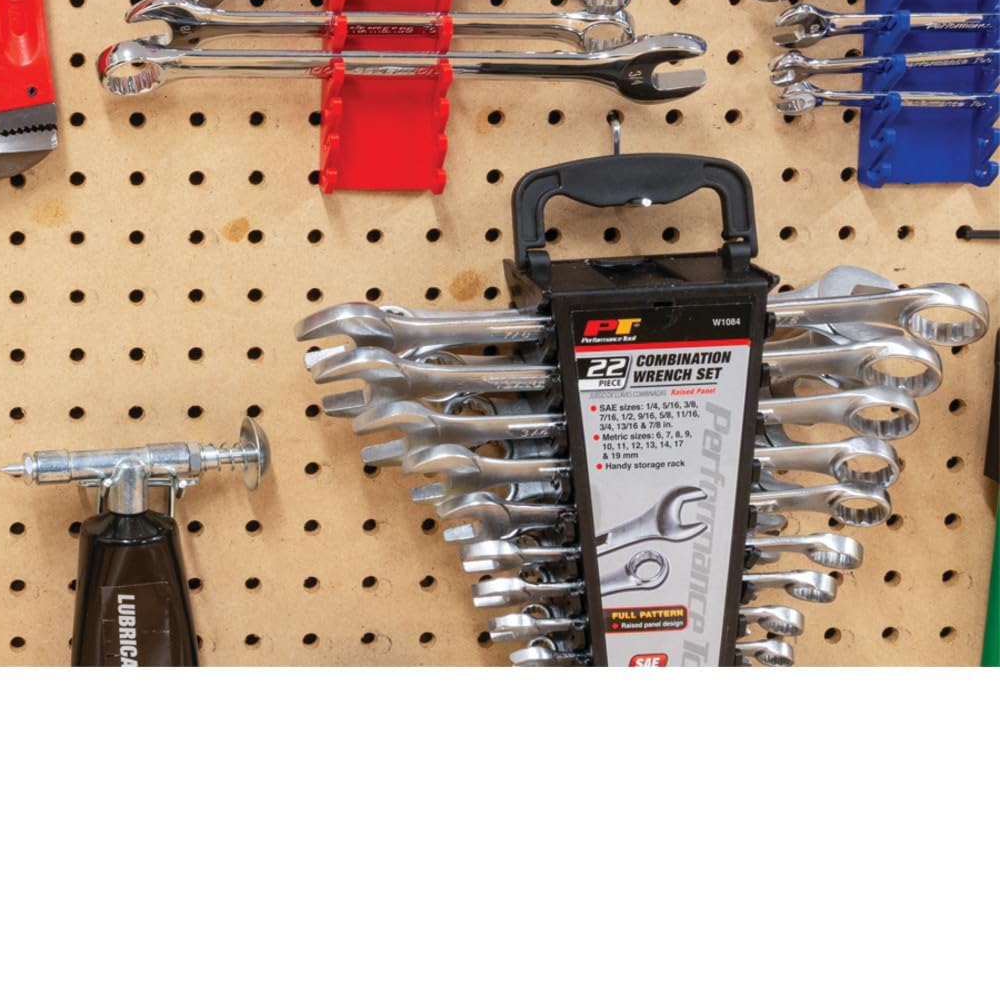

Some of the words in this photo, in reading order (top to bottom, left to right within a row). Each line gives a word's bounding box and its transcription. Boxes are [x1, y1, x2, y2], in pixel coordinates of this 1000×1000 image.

[583, 317, 642, 337] PT
[712, 318, 741, 327] W1084
[636, 351, 731, 367] COMBINATION
[586, 358, 625, 378] 22
[633, 369, 695, 383] WRENCH
[696, 367, 723, 380] SET
[599, 379, 622, 387] PIECE
[600, 404, 617, 412] SAE
[620, 403, 644, 411] sizes:
[646, 402, 660, 411] 1/4,
[621, 413, 636, 421] 1/2,
[617, 422, 639, 430] 13/16
[602, 433, 628, 441] Metric
[630, 432, 654, 440] sizes:
[617, 442, 629, 450] 11,
[631, 442, 643, 450] 12,
[660, 441, 672, 449] 14,
[674, 440, 684, 448] 17
[605, 462, 632, 471] Handy
[634, 461, 665, 469] storage
[667, 459, 686, 468] rack
[687, 401, 732, 635] Performance
[611, 611, 636, 620] FULL
[640, 608, 684, 619] PATTERN
[635, 657, 661, 667] SAE
